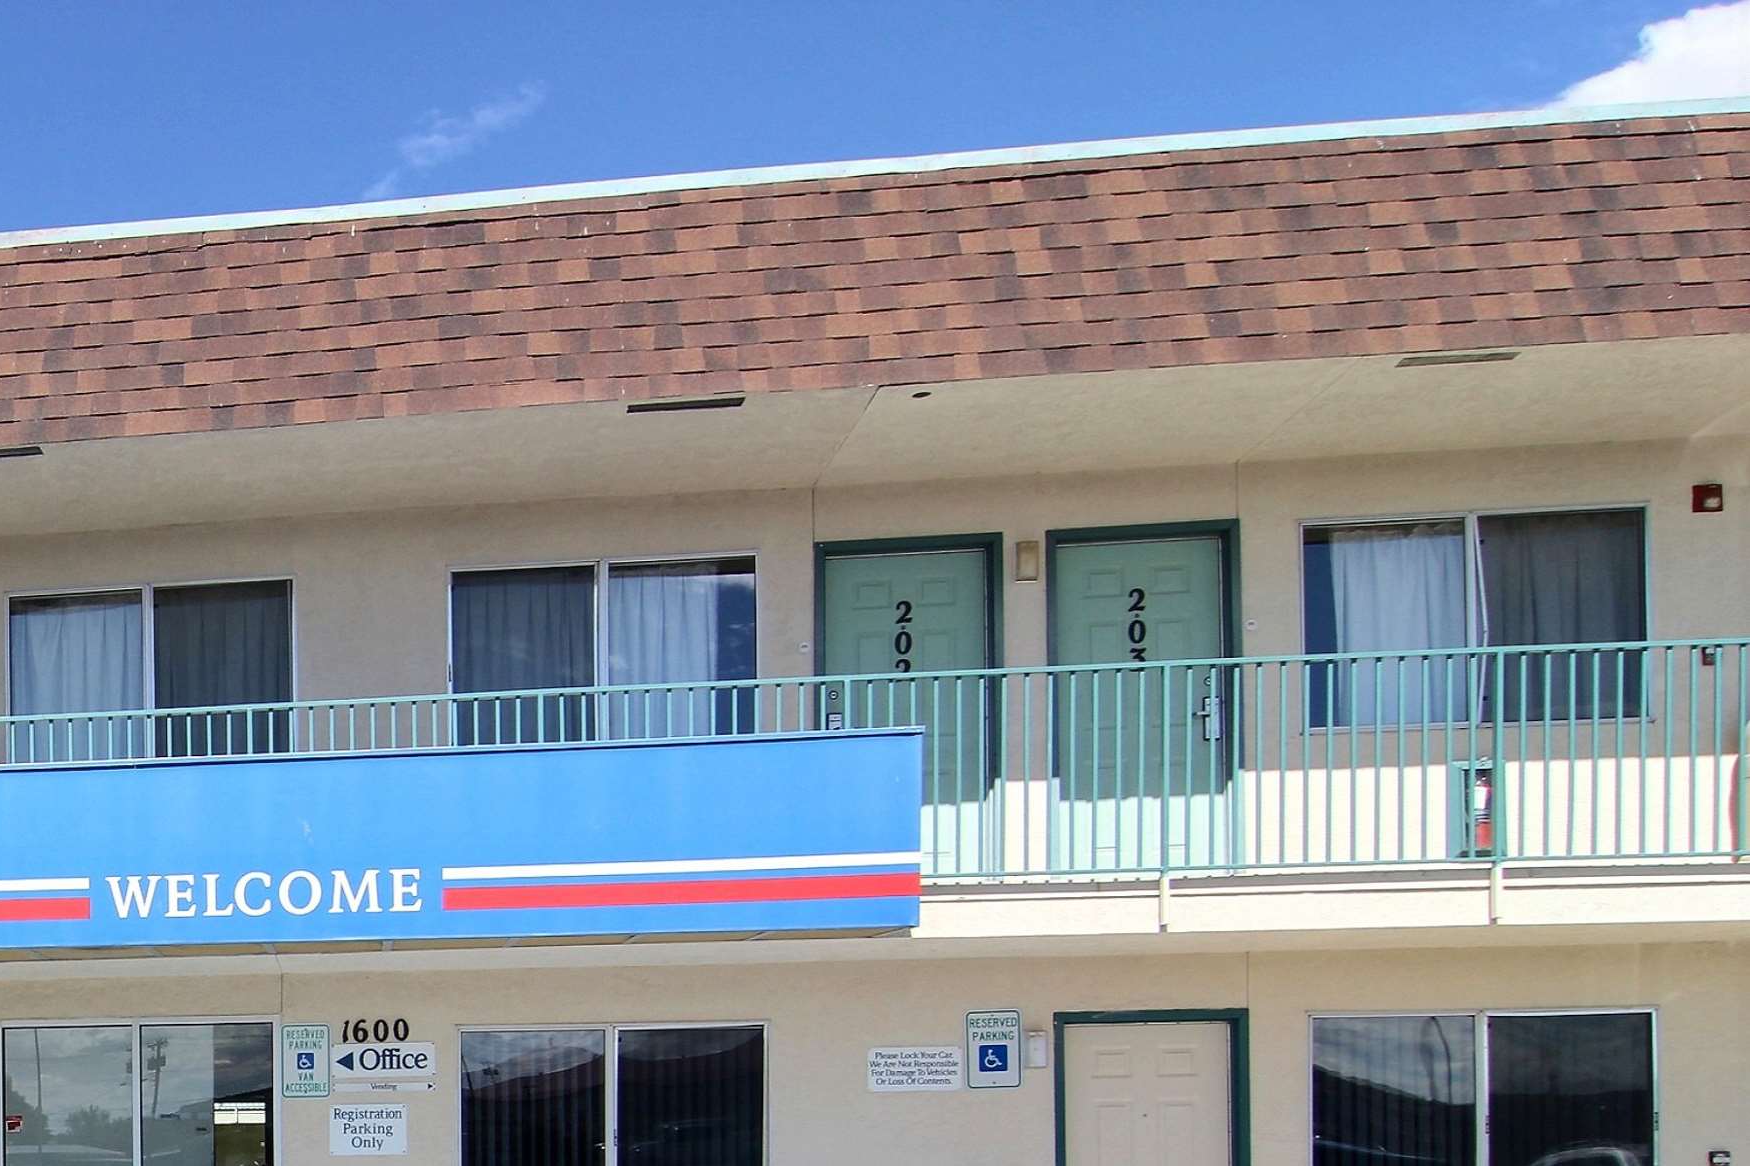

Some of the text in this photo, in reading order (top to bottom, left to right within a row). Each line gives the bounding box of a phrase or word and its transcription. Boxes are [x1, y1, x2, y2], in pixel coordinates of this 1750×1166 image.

[105, 868, 423, 919] WELCOME
[969, 1017, 1018, 1028] RESERVED
[286, 1029, 325, 1040] RESERVED
[342, 1018, 410, 1043] 1600
[972, 1031, 1015, 1041] PARKING
[289, 1040, 323, 1050] PARKING
[359, 1048, 428, 1070] Office
[875, 1051, 899, 1060] Please
[900, 1051, 919, 1059] Lock
[920, 1051, 937, 1059] Your
[869, 1060, 959, 1069] We Are Not Responsible
[297, 1072, 314, 1081] VAN
[870, 1068, 958, 1078] For Damage To Vehicles
[875, 1077, 887, 1086] Or
[888, 1077, 905, 1086] Loss
[905, 1077, 917, 1085] Of
[285, 1083, 327, 1093] ACCESSIBLE
[370, 1083, 397, 1091] Vending
[333, 1107, 402, 1122] Registration
[343, 1122, 393, 1137] Parking
[351, 1136, 384, 1150] Only
